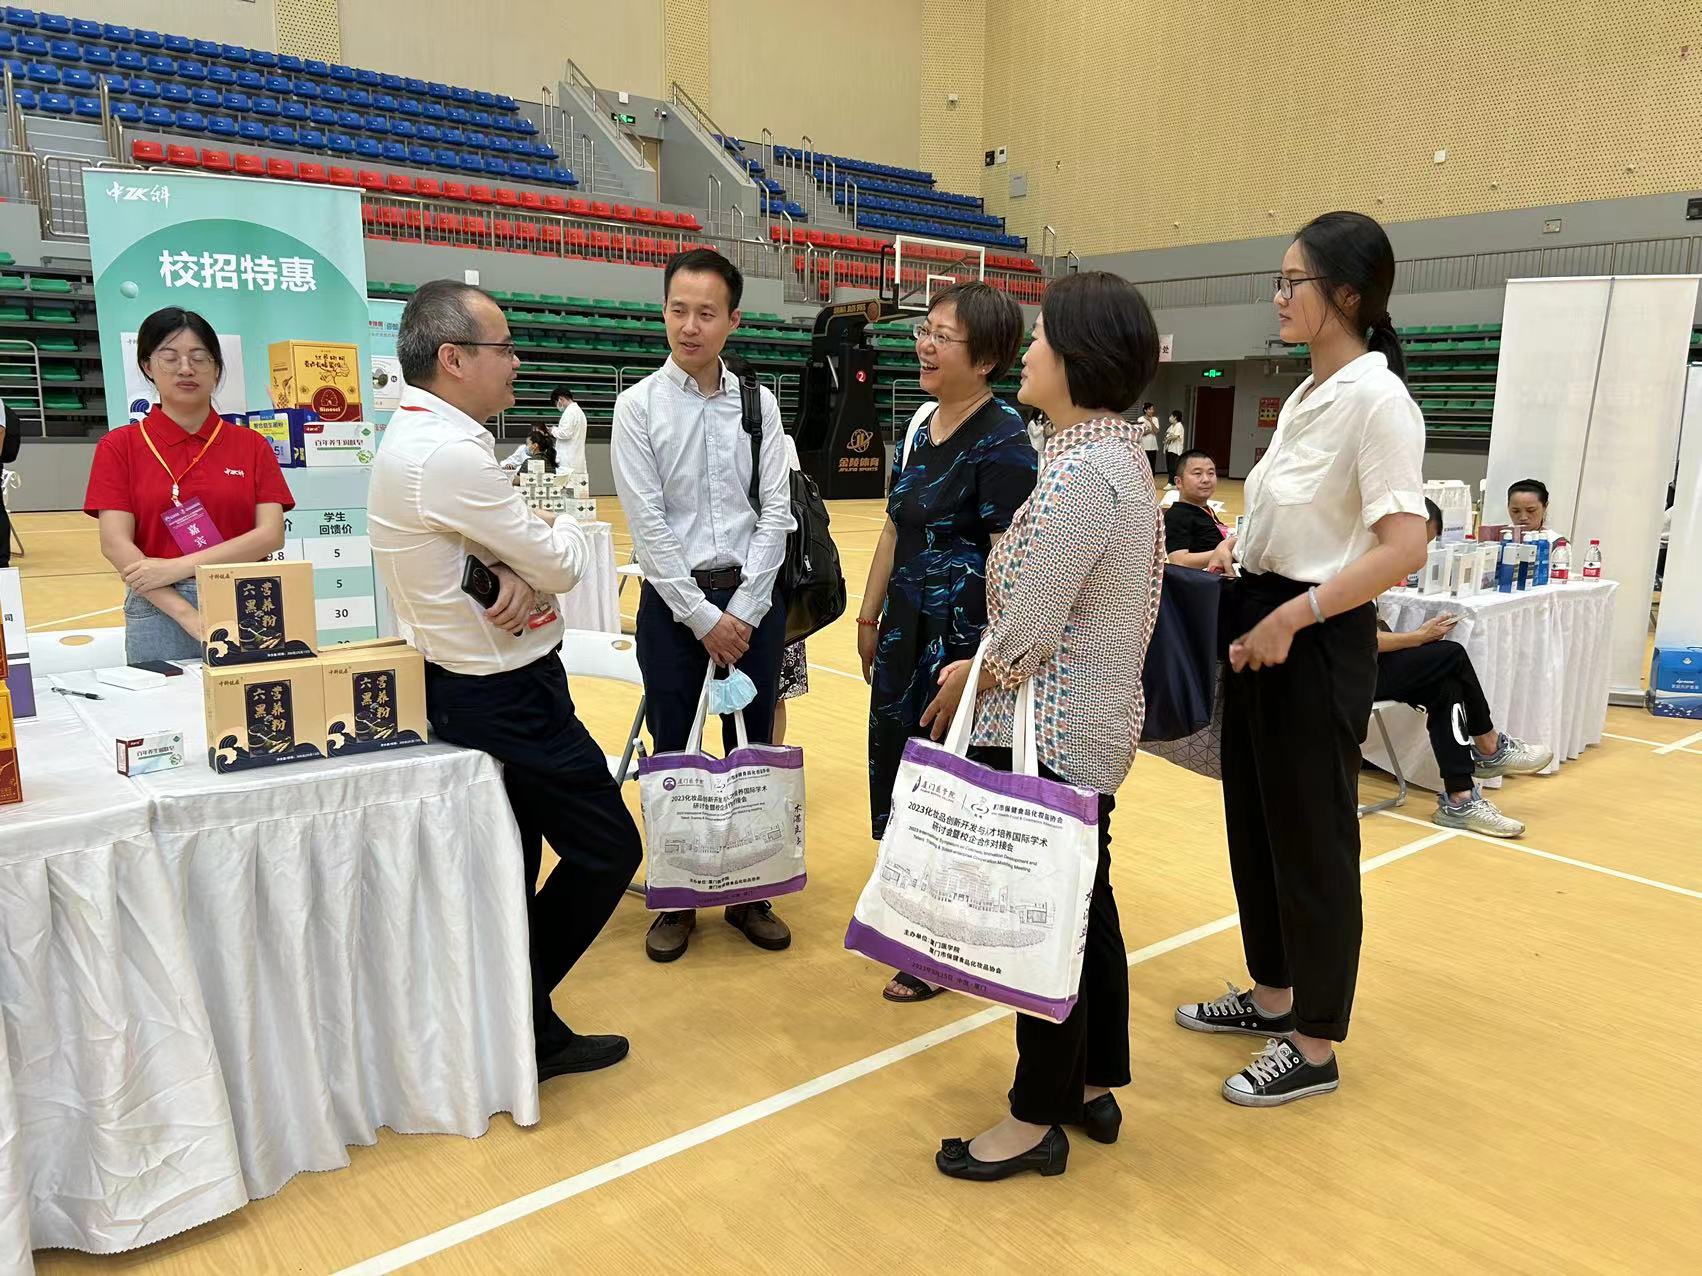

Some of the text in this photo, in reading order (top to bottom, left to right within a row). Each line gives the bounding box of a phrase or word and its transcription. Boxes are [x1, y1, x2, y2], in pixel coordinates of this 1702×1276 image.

[158, 249, 318, 292] 校招特惠
[857, 372, 865, 382] 2
[838, 457, 880, 468] 金陵体育
[323, 511, 347, 523] 学生
[319, 524, 353, 535] 回馈价
[334, 548, 341, 558] 5
[336, 579, 343, 588] 5
[334, 608, 349, 619] 30
